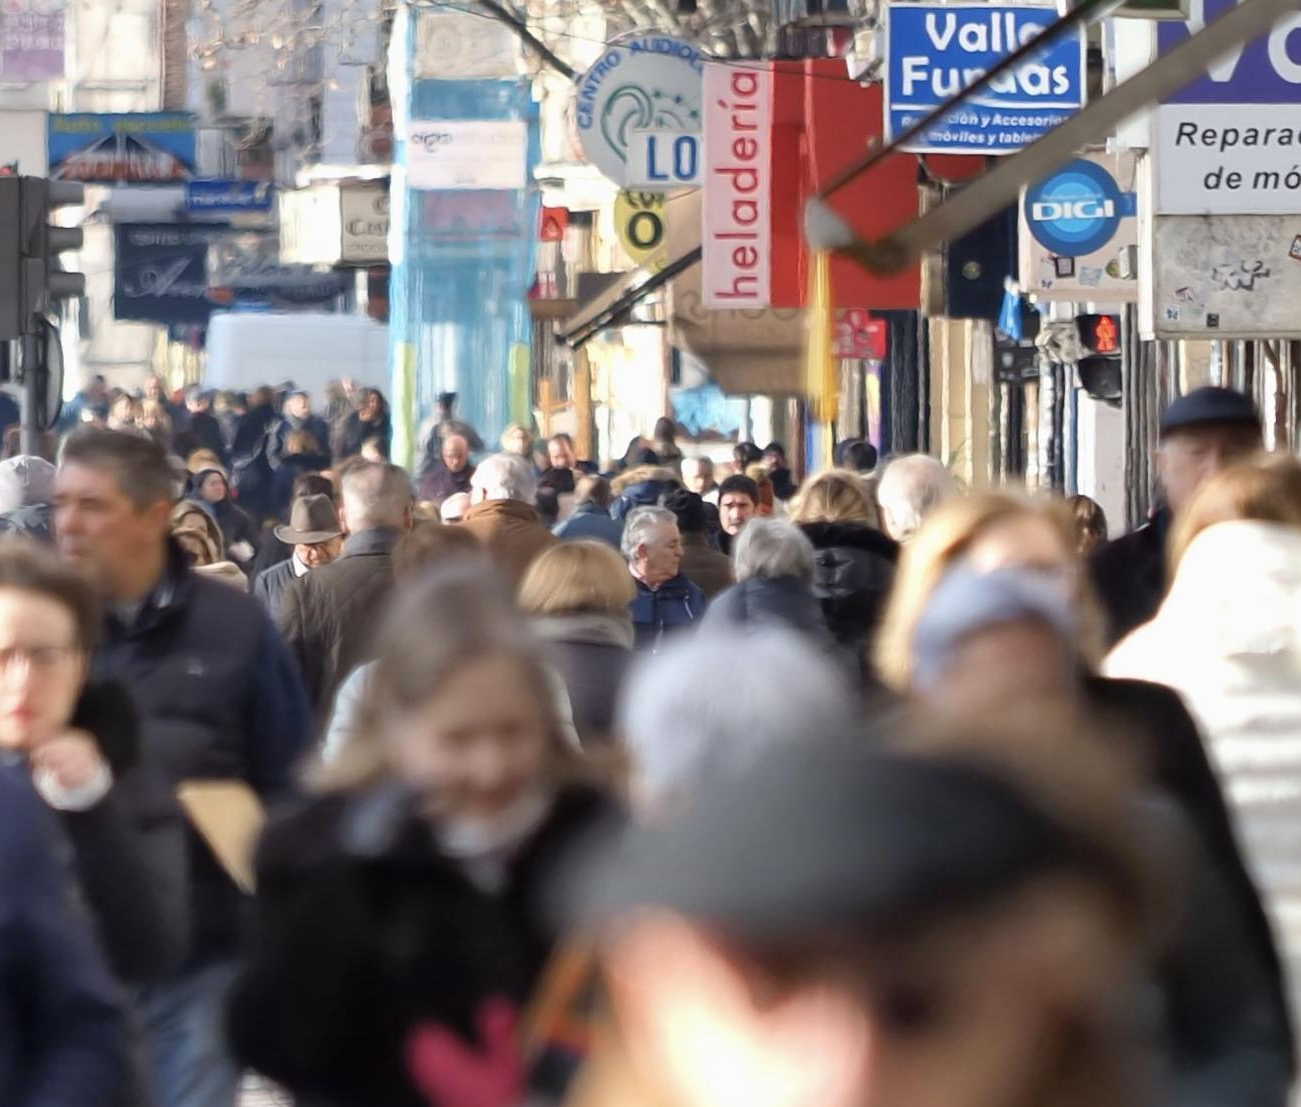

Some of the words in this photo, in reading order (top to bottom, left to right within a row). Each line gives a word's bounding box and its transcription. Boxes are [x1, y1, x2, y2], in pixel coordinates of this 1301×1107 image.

[577, 51, 620, 129] CENTRO
[980, 114, 991, 128] y
[648, 135, 697, 181] LO
[714, 71, 759, 298] heladería
[1203, 166, 1242, 190] de
[1032, 200, 1114, 221] DIGI
